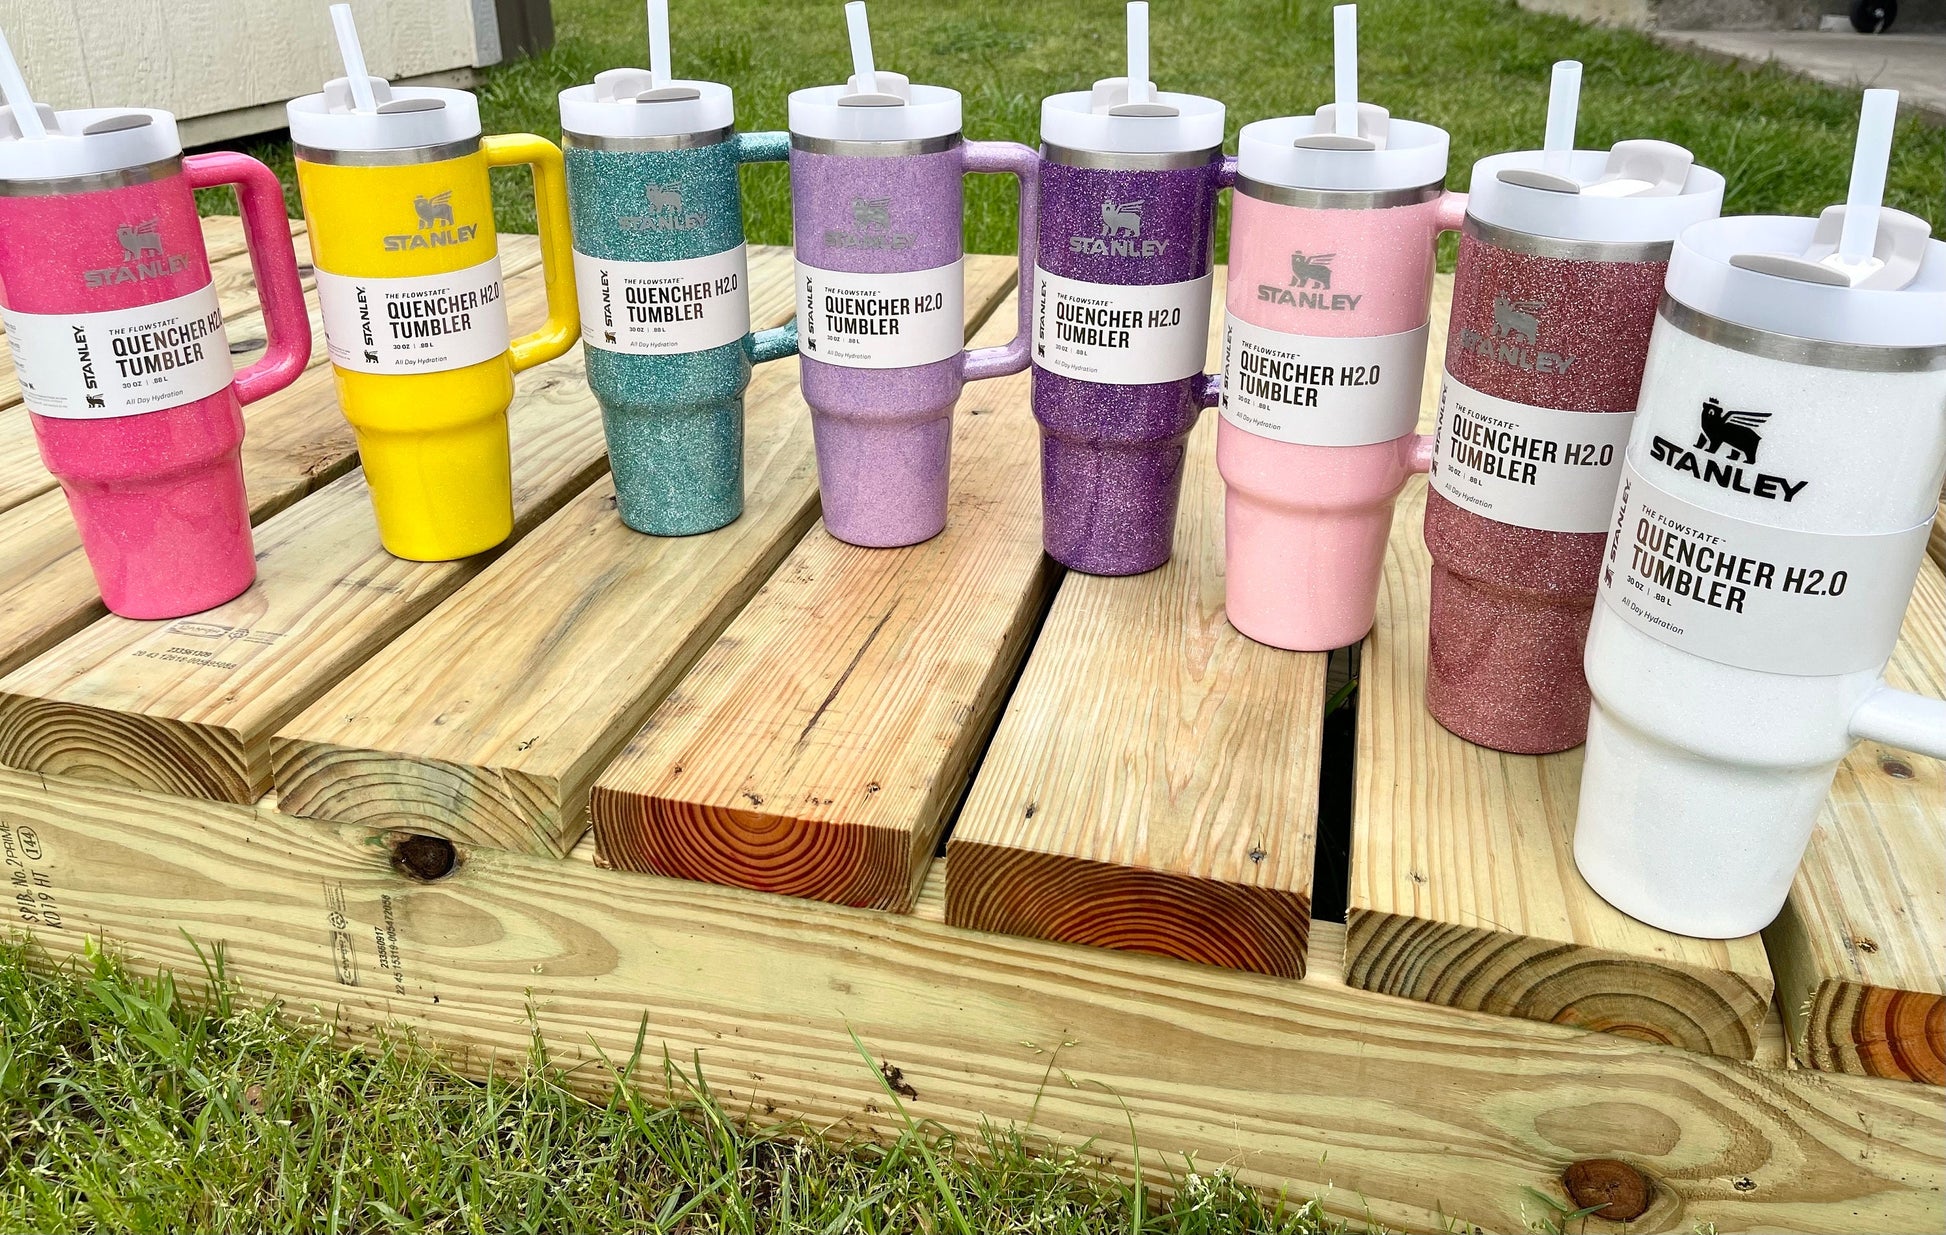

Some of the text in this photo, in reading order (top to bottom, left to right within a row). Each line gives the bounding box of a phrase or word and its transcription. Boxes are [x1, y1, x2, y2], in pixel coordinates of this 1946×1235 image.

[618, 213, 707, 231] STANLEY
[383, 223, 478, 252] STANLEY
[824, 230, 918, 249] STANLEY
[1069, 236, 1169, 257] STANLEY
[83, 254, 190, 288] STANLEY
[387, 281, 500, 319] QUENCHER H2.0
[600, 269, 613, 327] STANLEY
[625, 273, 738, 304] QUENCHER H2.0
[1257, 284, 1363, 311] STANLEY
[355, 286, 373, 346] STANLEY
[627, 303, 704, 323] TUMBLER
[806, 276, 814, 334] STANLEY
[825, 292, 943, 316] QUENCHER H2.0
[1056, 302, 1181, 328] QUENCHER H2.0
[109, 328, 126, 336] THE
[111, 318, 207, 357] QUENCHER
[389, 313, 472, 339] TUMBLER
[825, 315, 900, 335] TUMBLER
[1056, 321, 1130, 348] TUMBLER
[72, 325, 97, 389] STANLEY
[1242, 340, 1252, 349] THE
[1460, 328, 1577, 375] STANLEY
[116, 342, 204, 378] TUMBLER
[1240, 350, 1381, 387] QUENCHER H2.0
[152, 390, 184, 400] Hydration
[1240, 371, 1318, 408] TUMBLER
[1456, 403, 1466, 414] THE
[1453, 414, 1614, 467] QUENCHER H2.0
[1451, 436, 1537, 486] TUMBLER
[1650, 436, 1809, 503] STANLEY
[1610, 478, 1631, 563] STANLEY
[1641, 504, 1656, 519] THE
[1636, 517, 1848, 597] QUENCHER H2.0
[1632, 544, 1747, 614] TUMBLER
[1622, 596, 1684, 635] All Day Hydration
[21, 832, 39, 854] 144
[31, 869, 52, 888] HT
[397, 985, 405, 996] 22
